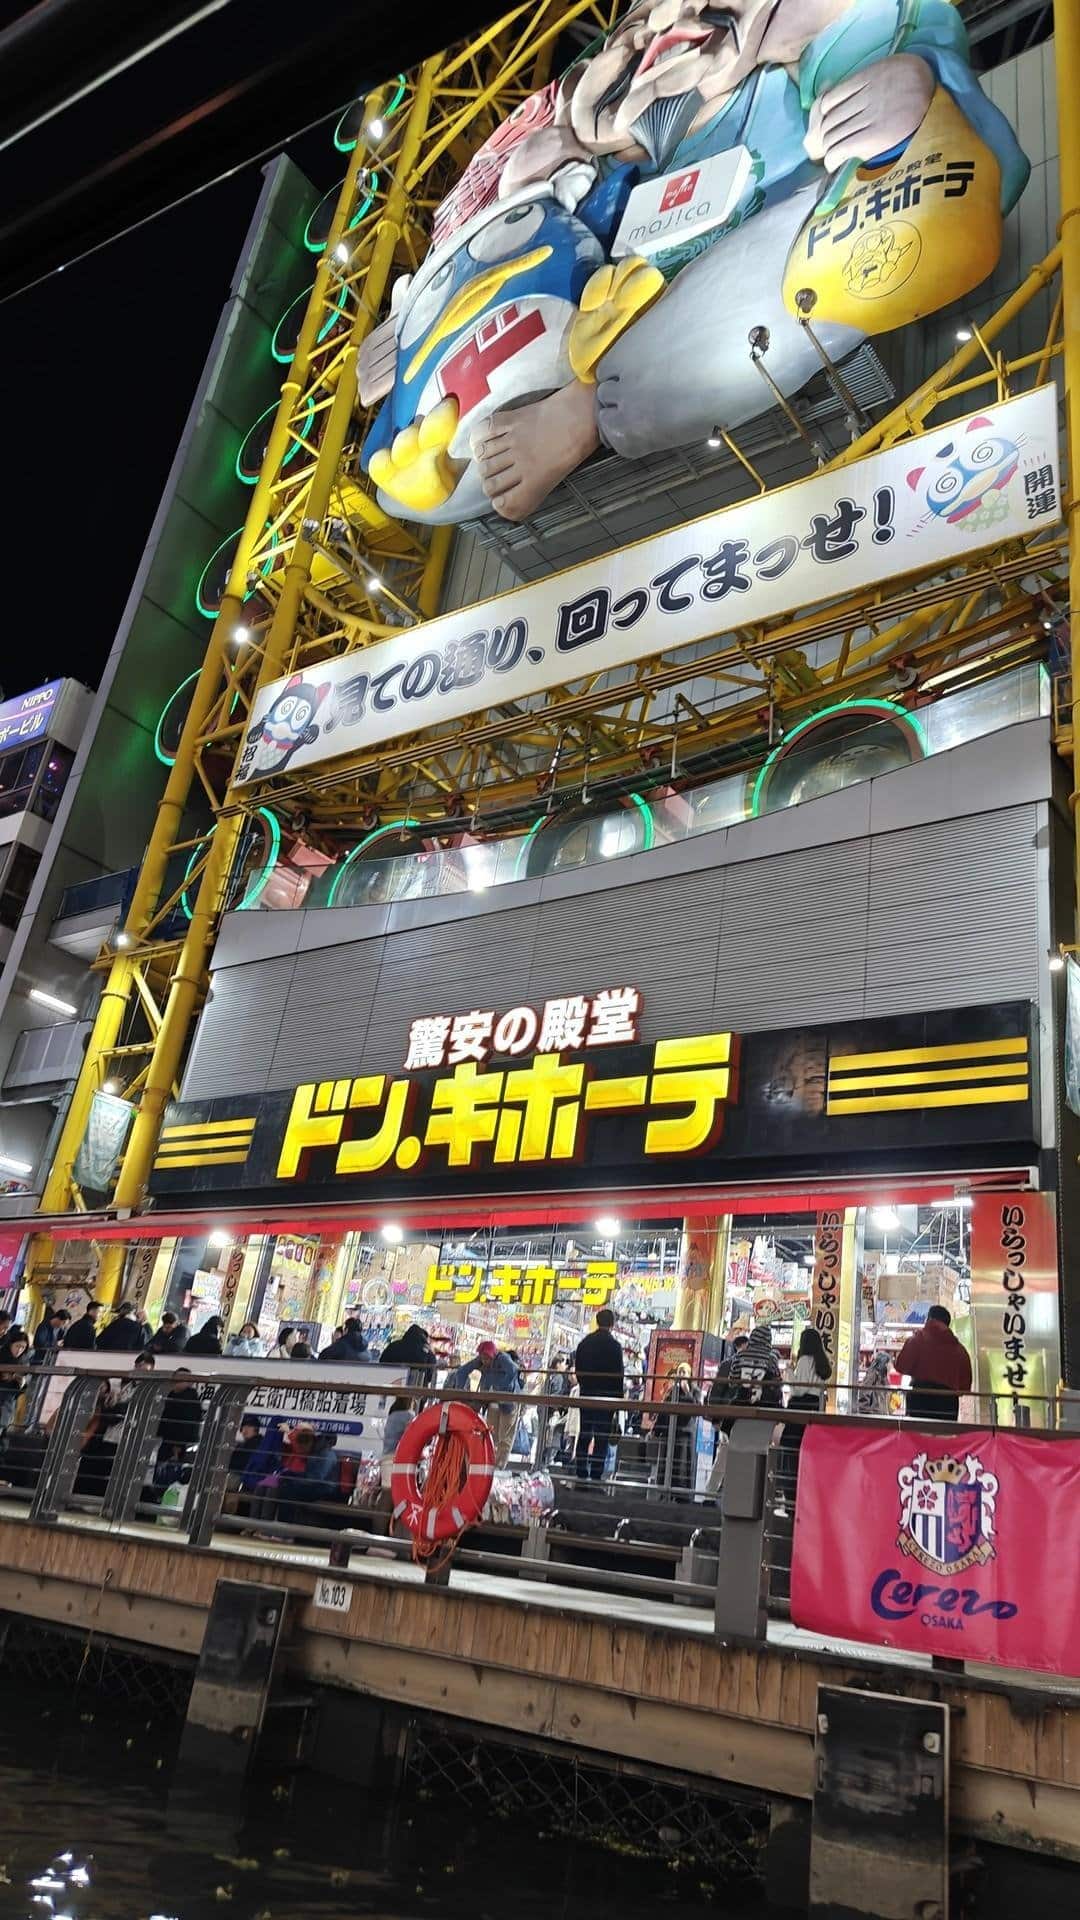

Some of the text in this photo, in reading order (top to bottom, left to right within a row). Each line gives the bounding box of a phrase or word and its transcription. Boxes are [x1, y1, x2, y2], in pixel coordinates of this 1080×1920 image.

[1024, 464, 1057, 519] 開運
[22, 689, 54, 711] NIPPO
[404, 986, 640, 1071] 驚安の殿堂
[871, 1568, 1018, 1620] Cerezo
[921, 1613, 964, 1631] OSAKA
